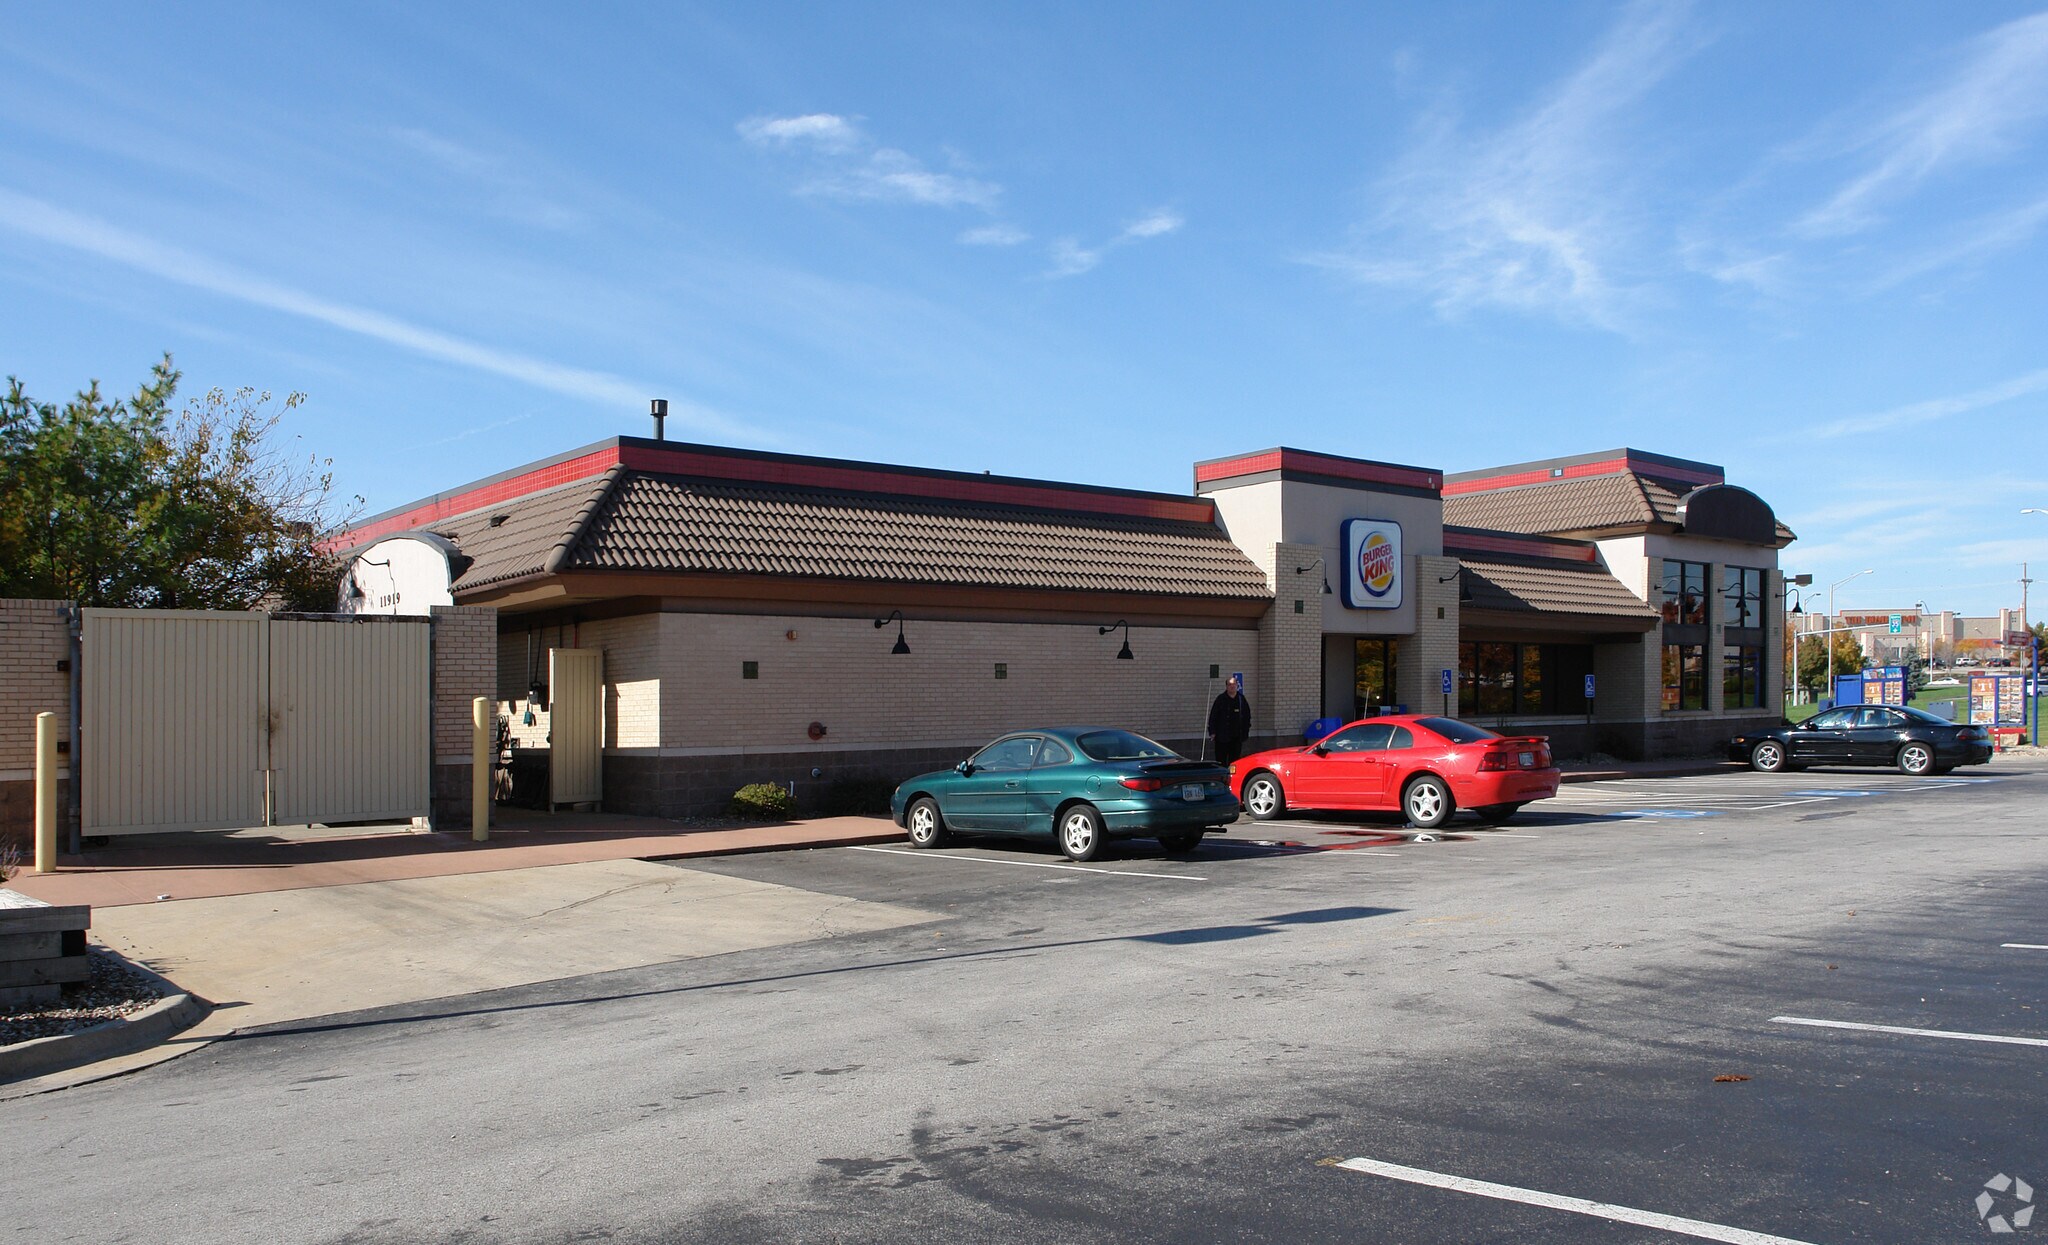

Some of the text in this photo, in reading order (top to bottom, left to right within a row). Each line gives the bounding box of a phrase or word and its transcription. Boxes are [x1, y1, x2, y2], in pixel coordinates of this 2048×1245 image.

[1363, 544, 1393, 566] BURGER
[1364, 555, 1394, 583] KING
[380, 592, 400, 608] 11919
